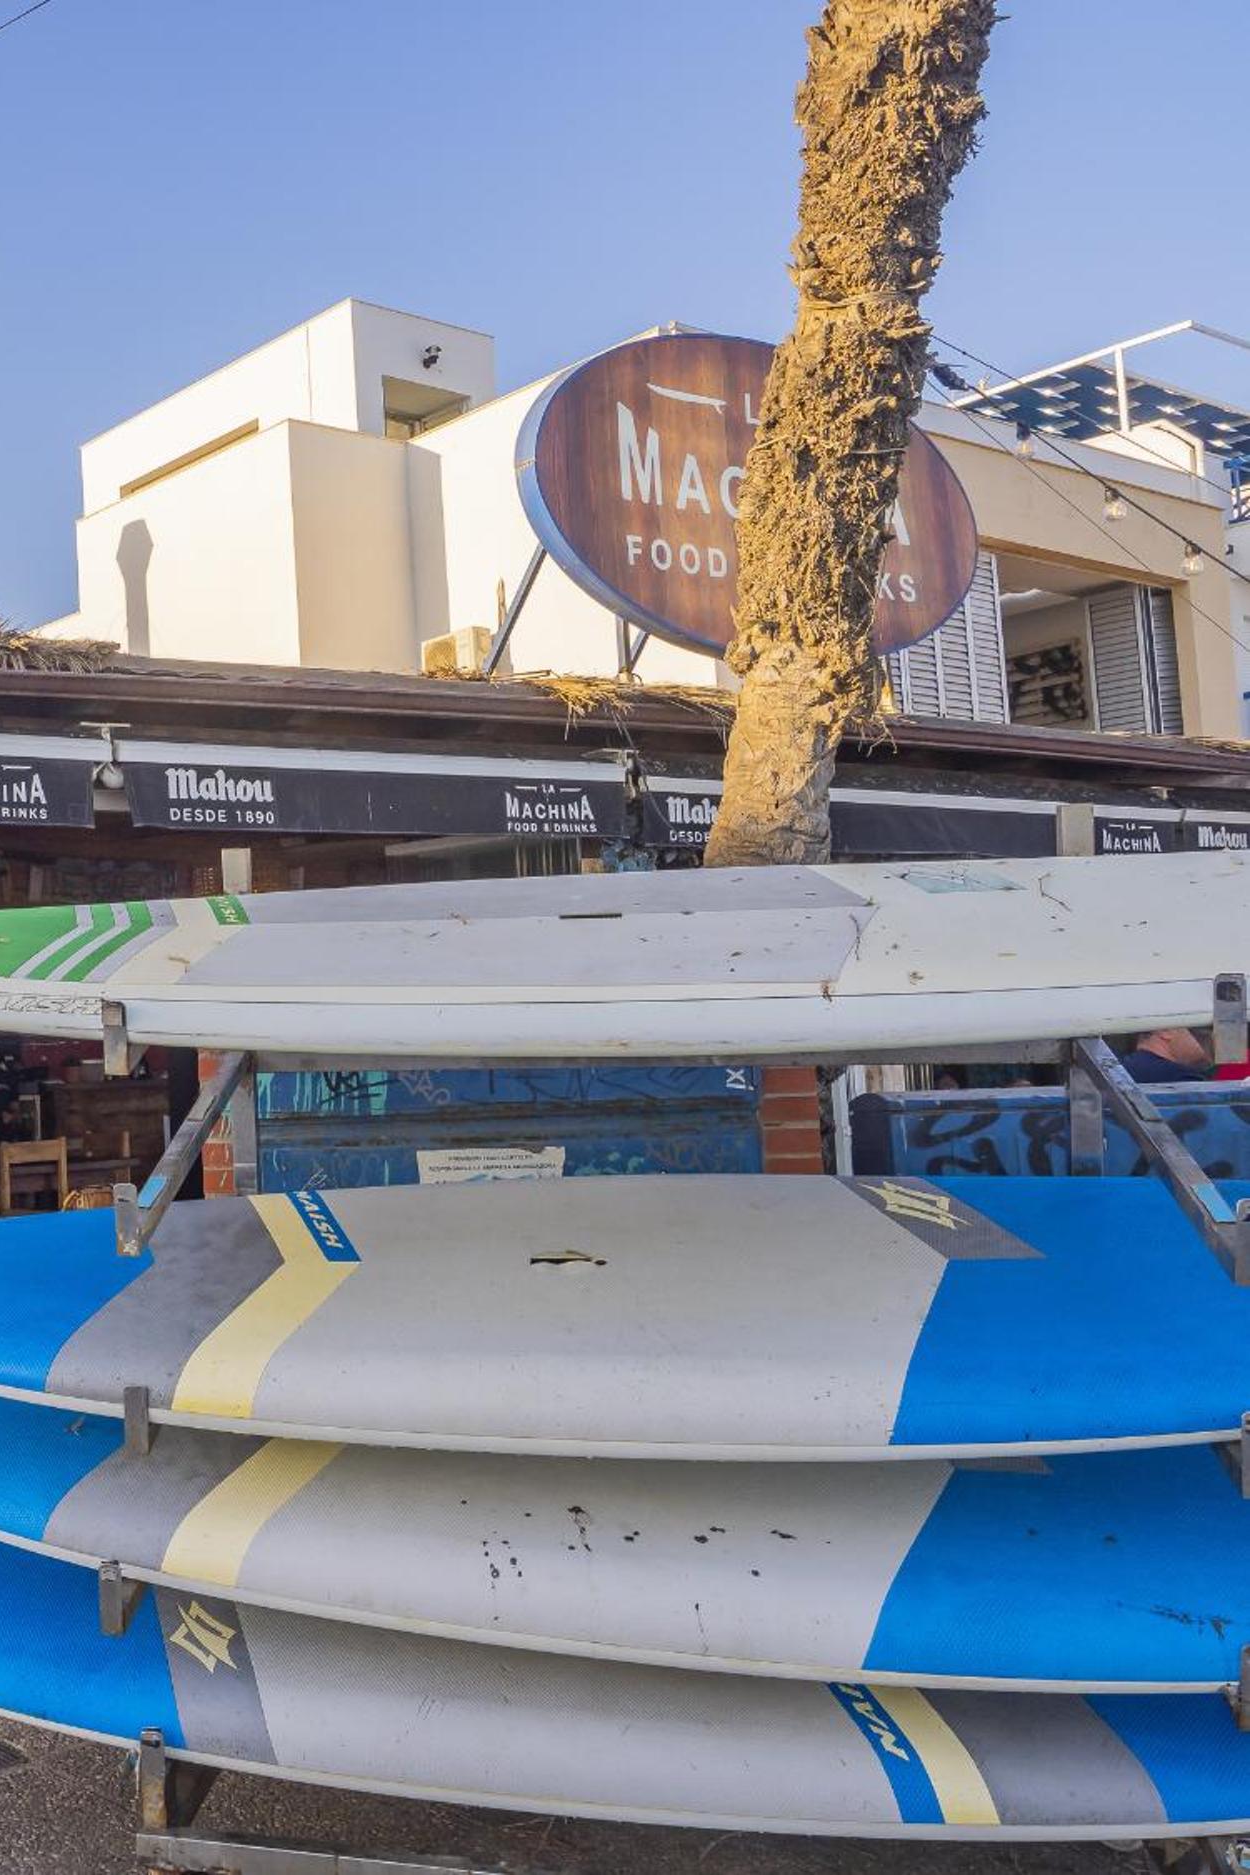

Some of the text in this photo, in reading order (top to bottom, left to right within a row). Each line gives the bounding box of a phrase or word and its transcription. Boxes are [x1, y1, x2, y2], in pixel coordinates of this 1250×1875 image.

[626, 534, 728, 578] FOOD
[164, 767, 274, 802] Mahou
[170, 807, 275, 824] DESDE 1890
[505, 791, 595, 821] MACHINA
[666, 796, 719, 825] Mah
[507, 822, 538, 833] FOOD
[554, 822, 598, 834] DRINKS
[1197, 825, 1249, 849] Mahou
